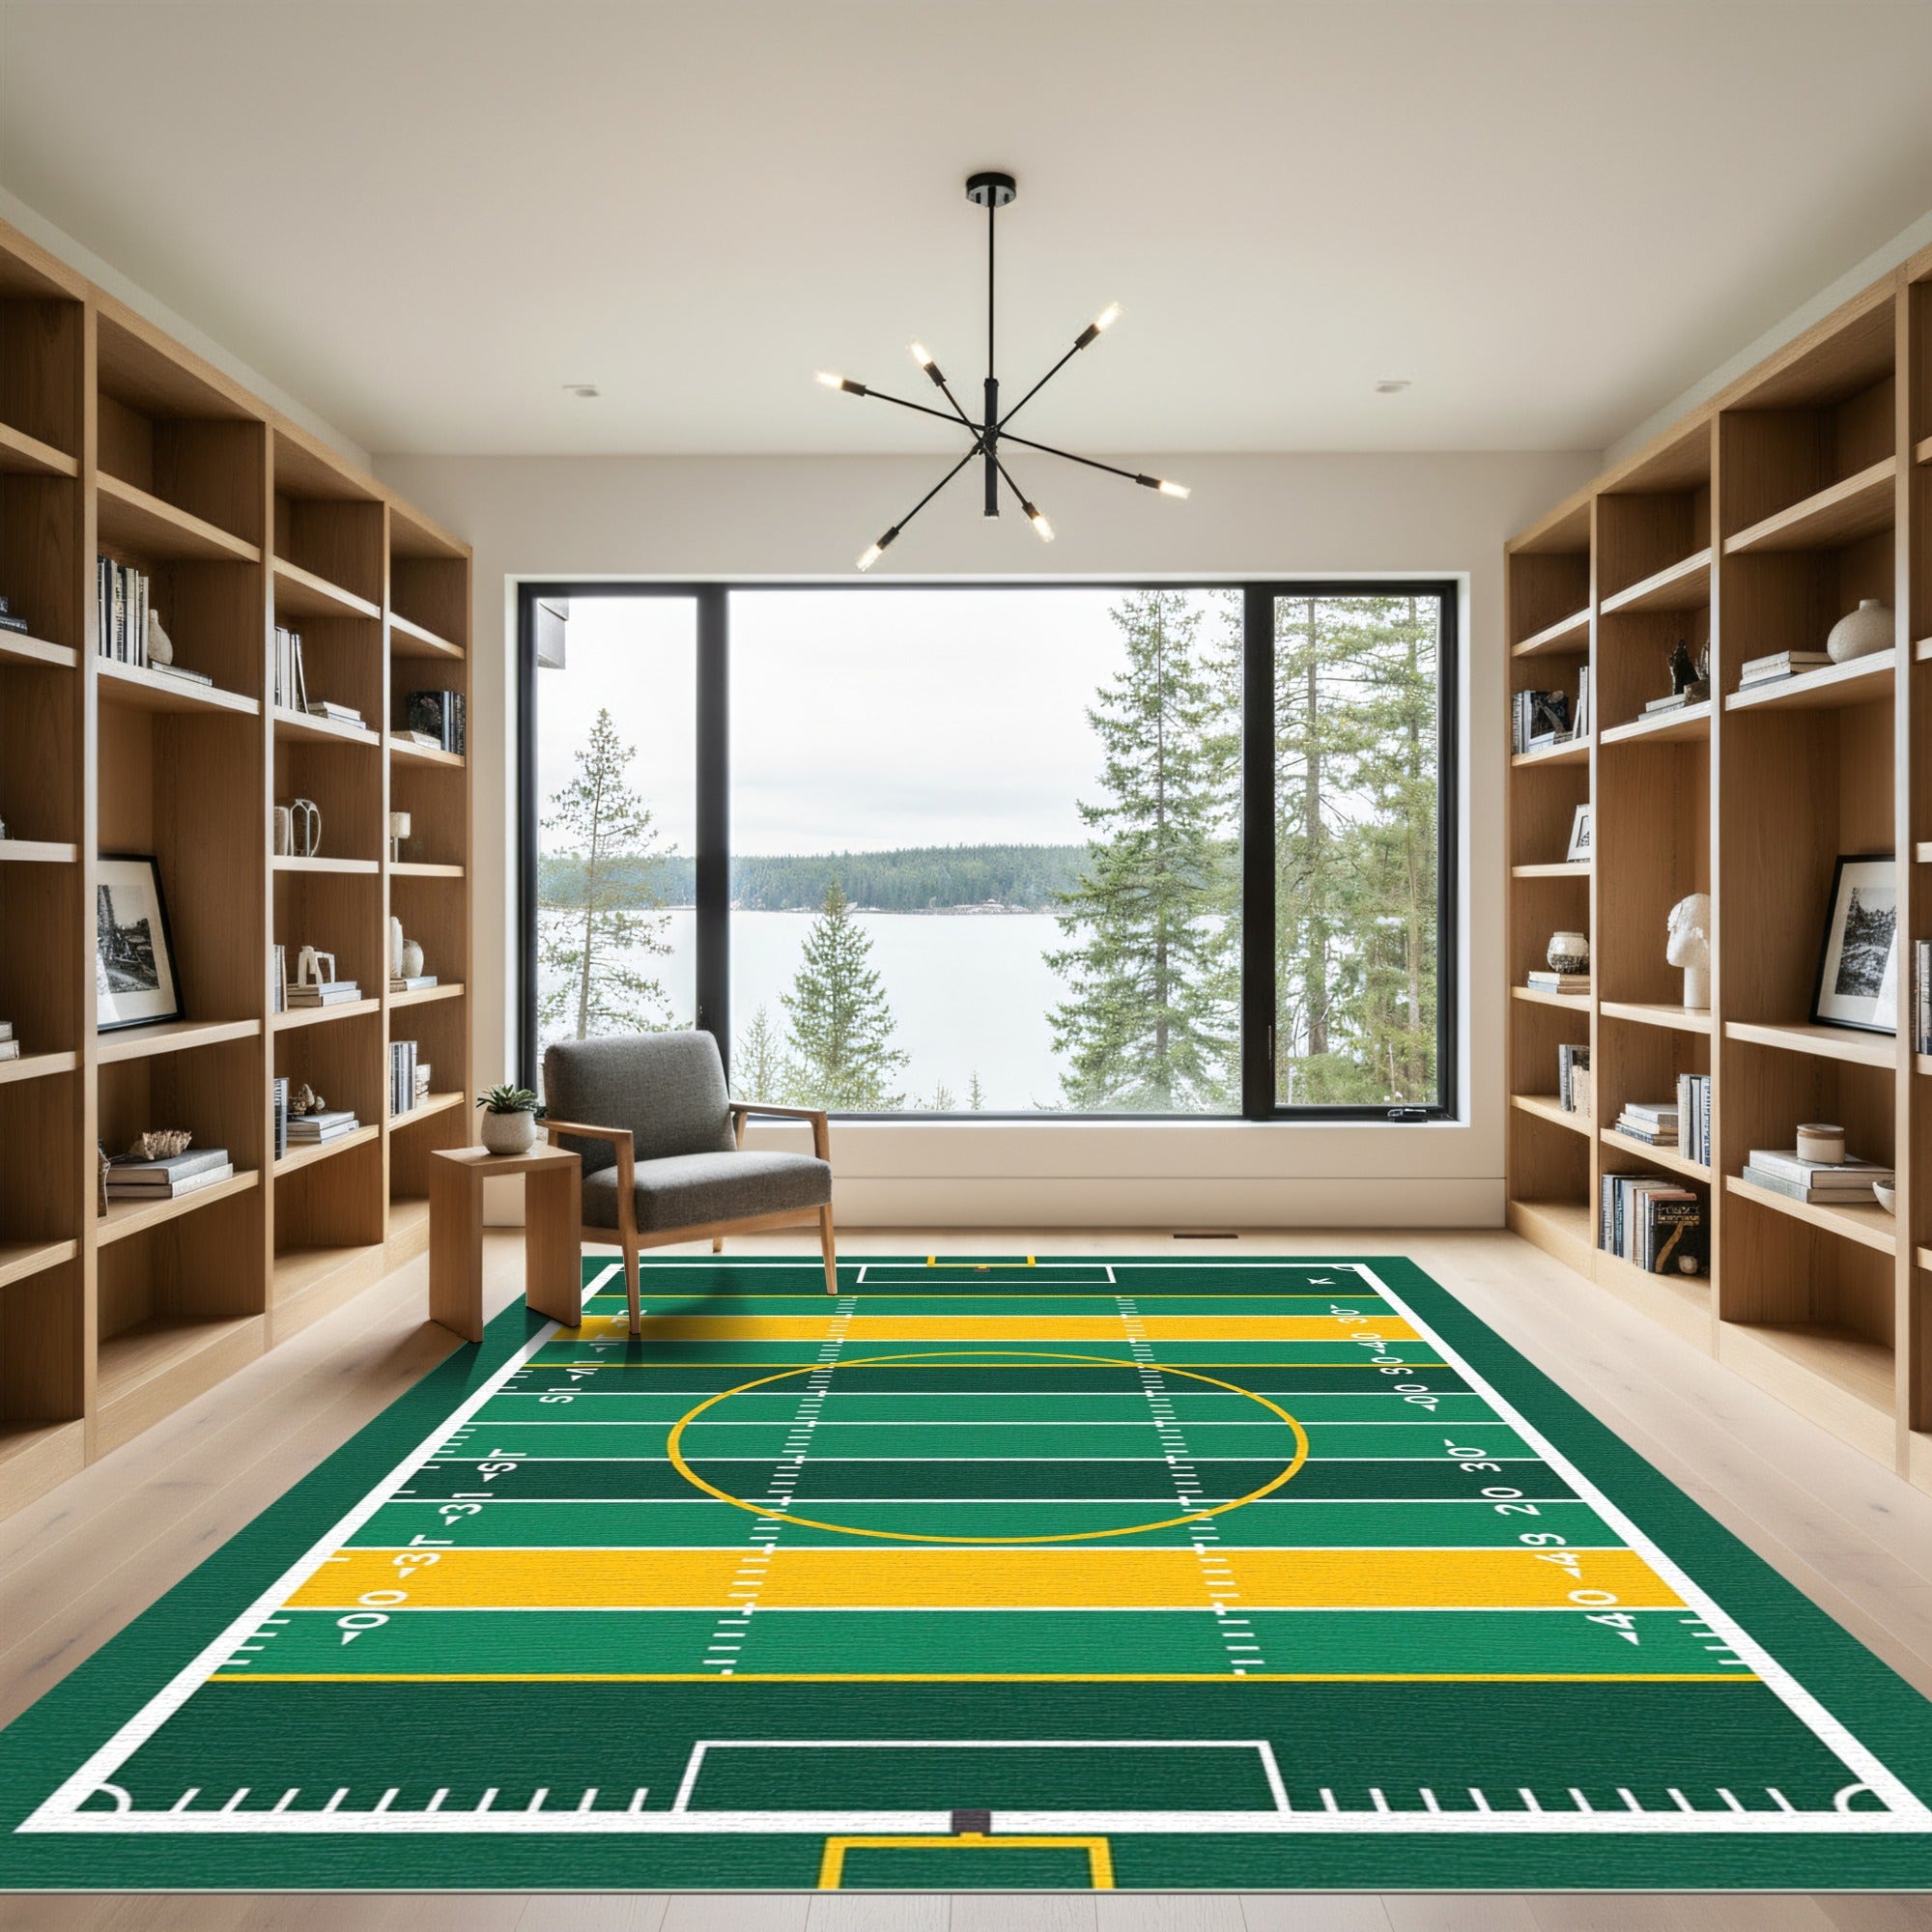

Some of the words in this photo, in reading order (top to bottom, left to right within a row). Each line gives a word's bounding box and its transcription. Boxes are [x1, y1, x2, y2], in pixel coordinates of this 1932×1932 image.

[1330, 1309, 1368, 1323] 30
[1350, 1332, 1388, 1349] 40
[1447, 1447, 1502, 1472] 30
[1480, 1487, 1541, 1516] 20
[1567, 1589, 1636, 1630] 40
